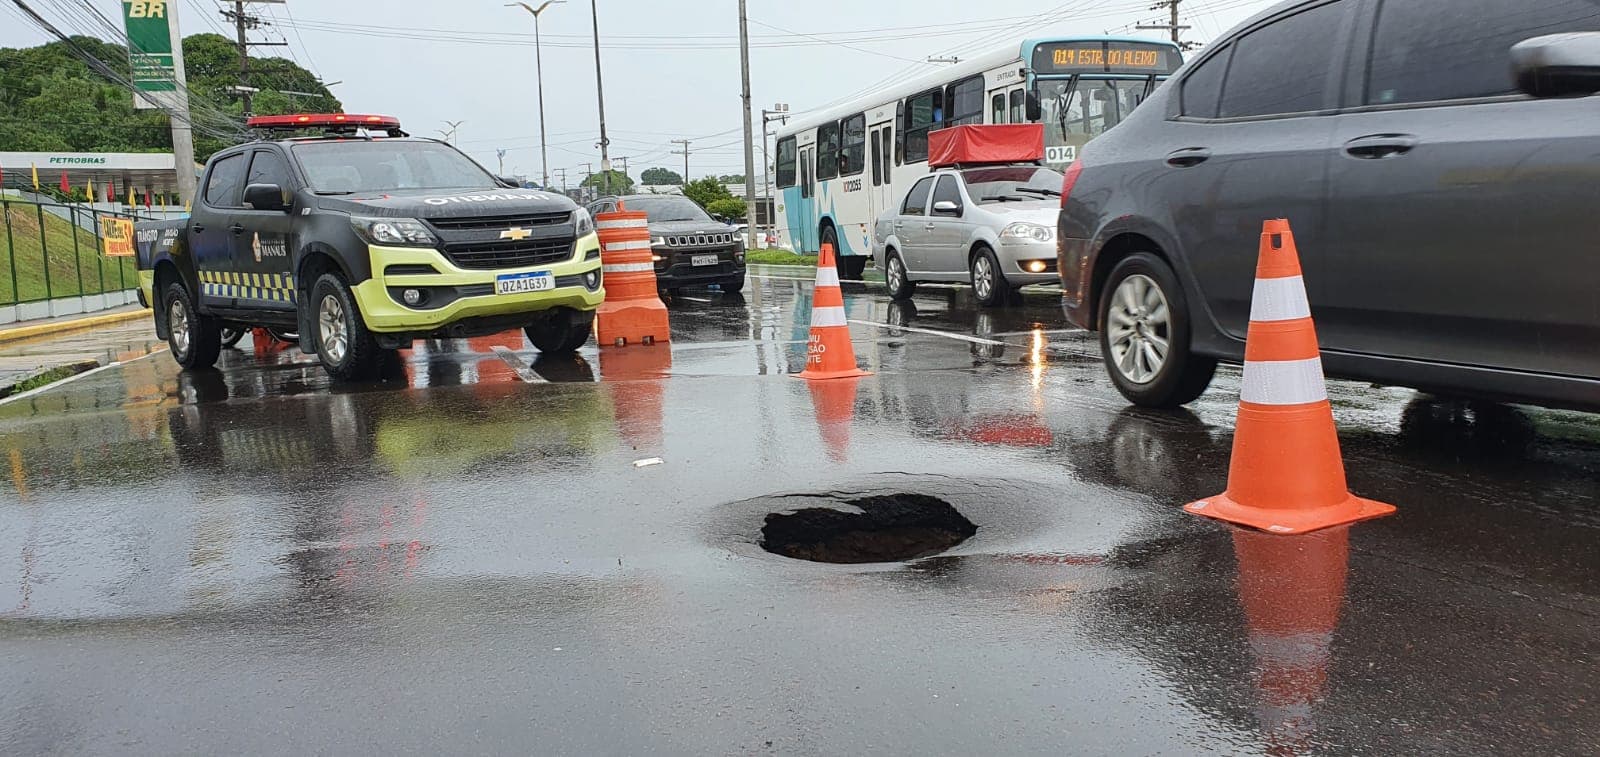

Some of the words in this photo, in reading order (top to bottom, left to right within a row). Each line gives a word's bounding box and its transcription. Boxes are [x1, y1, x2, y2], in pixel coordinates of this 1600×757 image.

[129, 0, 164, 18] BR
[1054, 49, 1074, 65] 014
[1107, 50, 1121, 65] DO
[1047, 148, 1074, 160] 014
[502, 277, 548, 292] QZA1G39
